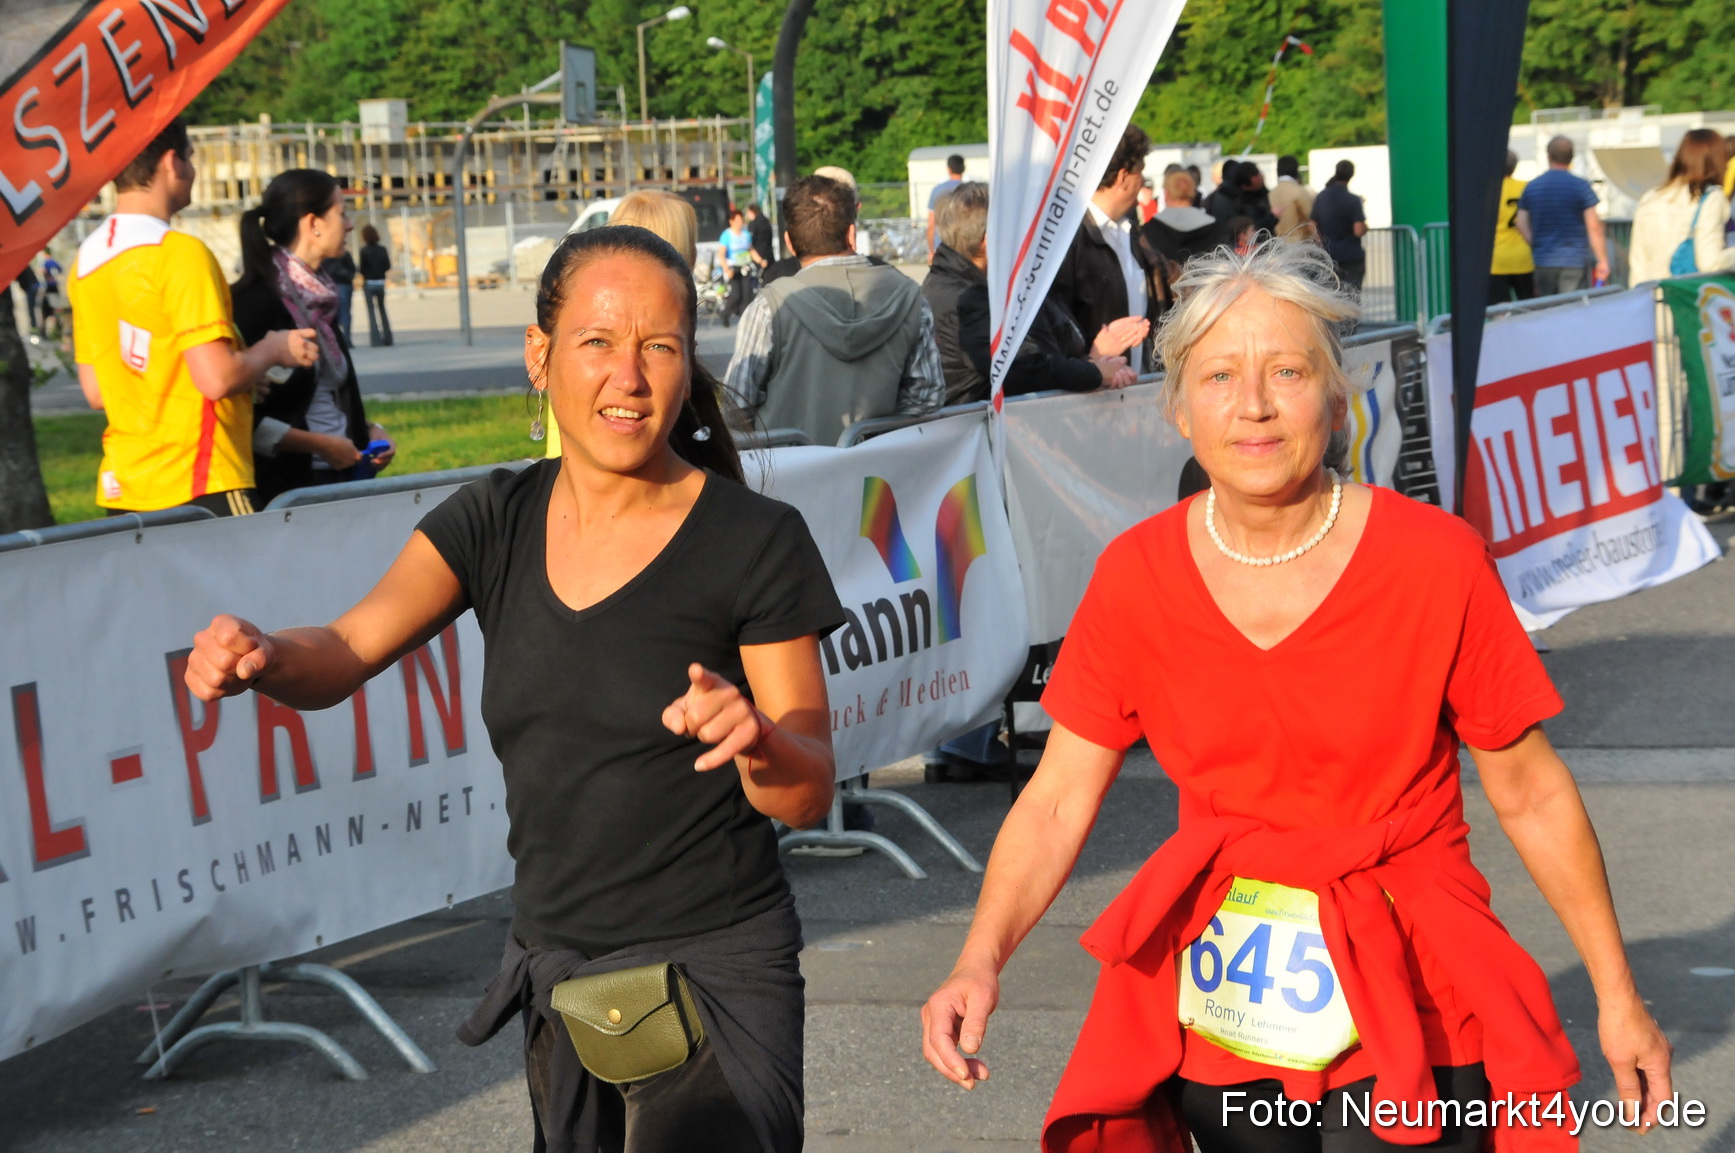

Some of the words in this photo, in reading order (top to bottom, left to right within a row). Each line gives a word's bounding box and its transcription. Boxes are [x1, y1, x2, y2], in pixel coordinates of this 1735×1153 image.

[1045, 0, 1109, 59] P
[900, 669, 972, 708] Medien
[1190, 915, 1335, 1014] 645
[1204, 997, 1247, 1028] Romy
[1220, 1026, 1237, 1039] Road
[1238, 1030, 1269, 1046] Runners
